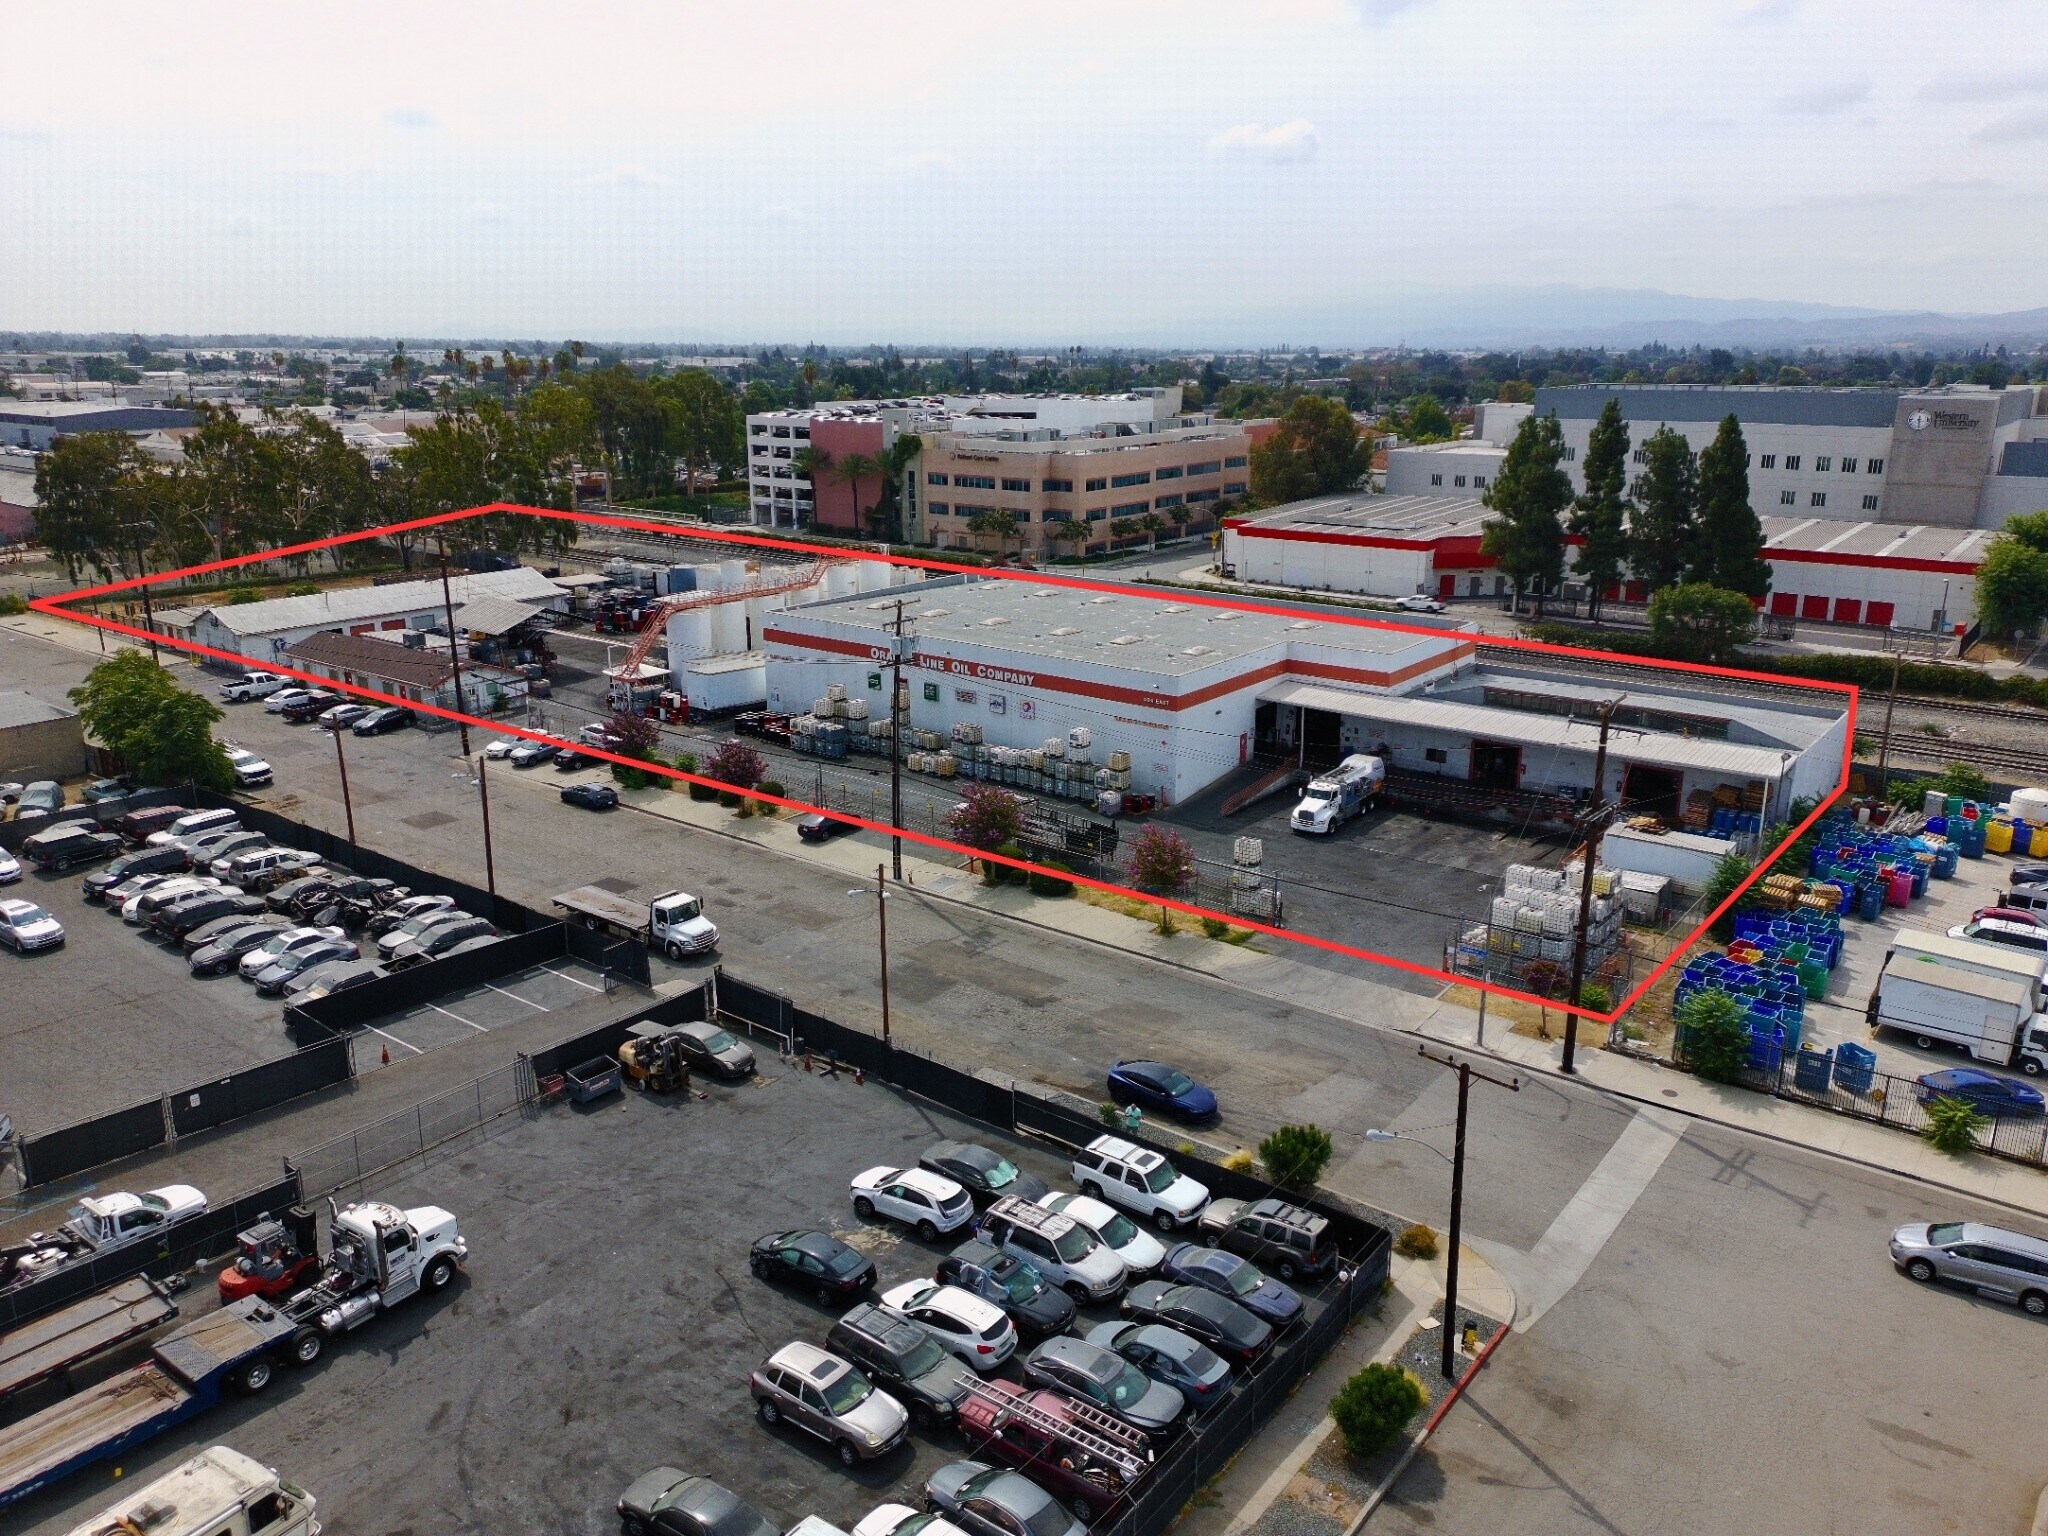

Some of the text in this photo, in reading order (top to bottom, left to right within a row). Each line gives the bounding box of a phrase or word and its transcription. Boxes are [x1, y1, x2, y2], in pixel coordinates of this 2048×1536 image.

[1934, 411, 1969, 420] Western
[1934, 419, 1979, 430] University
[919, 655, 945, 671] LINE
[951, 661, 971, 675] OIL
[976, 665, 1035, 686] COMPANY
[1155, 698, 1169, 706] EAST
